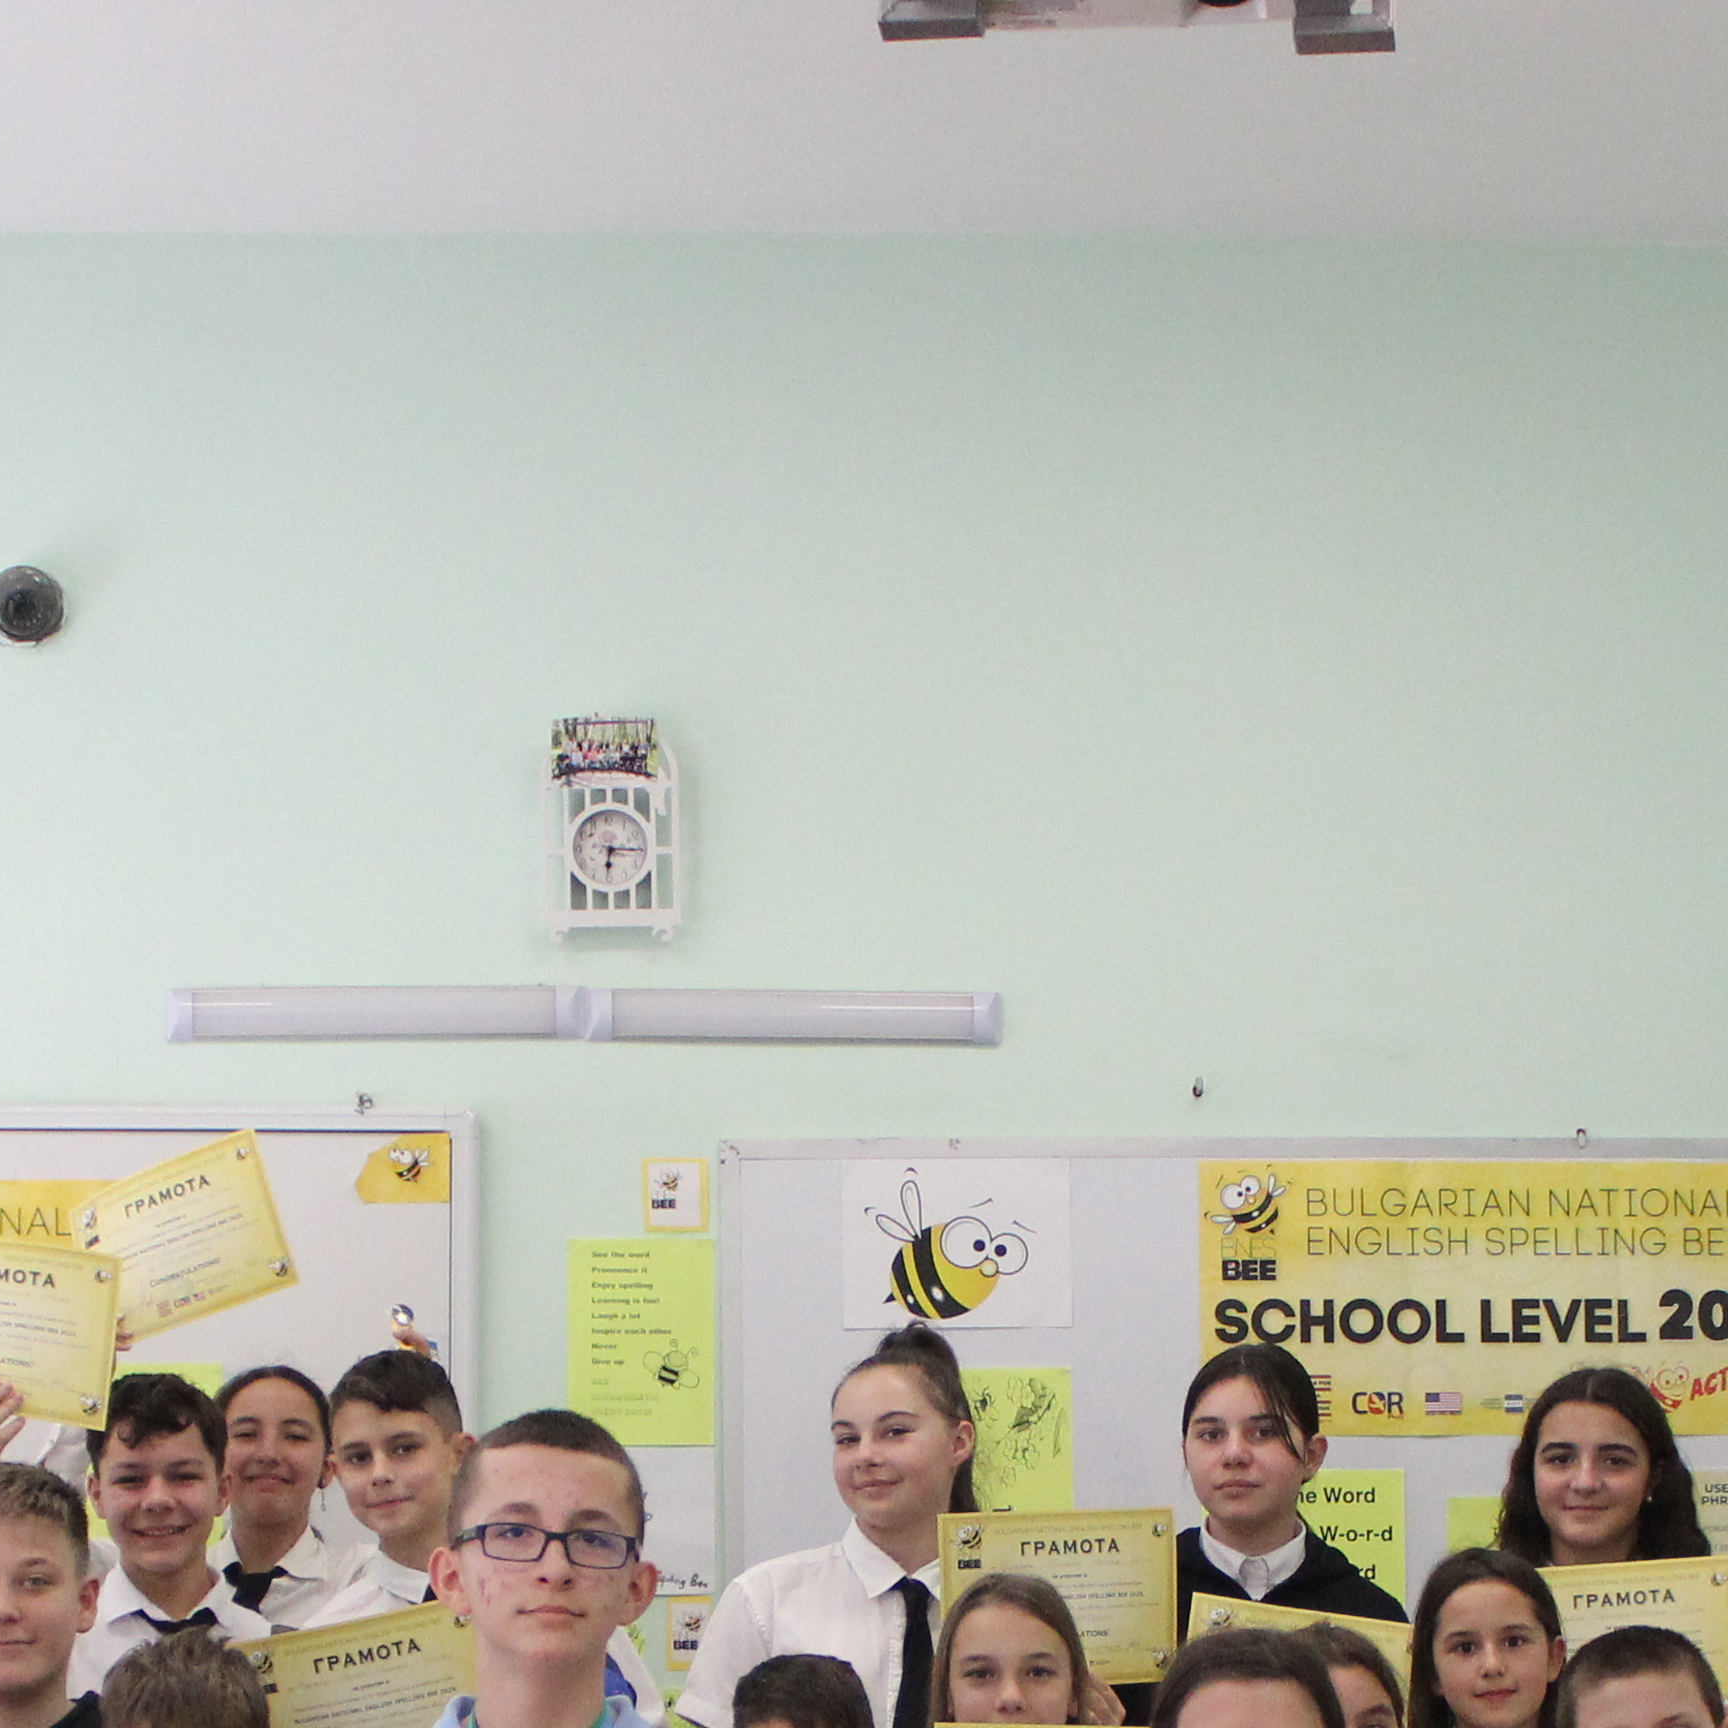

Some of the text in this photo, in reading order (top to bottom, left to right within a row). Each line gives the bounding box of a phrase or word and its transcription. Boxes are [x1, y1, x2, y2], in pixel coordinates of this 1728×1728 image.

[124, 1173, 211, 1218] ГРАМОТА
[651, 1198, 676, 1209] BEE
[1306, 1187, 1530, 1218] BULGARIAN
[1306, 1226, 1469, 1256] ENGLISH
[1485, 1226, 1672, 1256] SPELLING
[1222, 1259, 1277, 1281] BEE
[1214, 1298, 1465, 1344] SCHOOL
[1479, 1298, 1647, 1344] LEVEL
[1323, 1487, 1376, 1504] Word
[1319, 1525, 1394, 1542] W-o-r-d
[1019, 1537, 1120, 1557] ГРАМОТА
[1573, 1588, 1675, 1610] ГРАМОТА
[313, 1637, 422, 1674] ГРАМОТА
[673, 1640, 698, 1651] BEE
